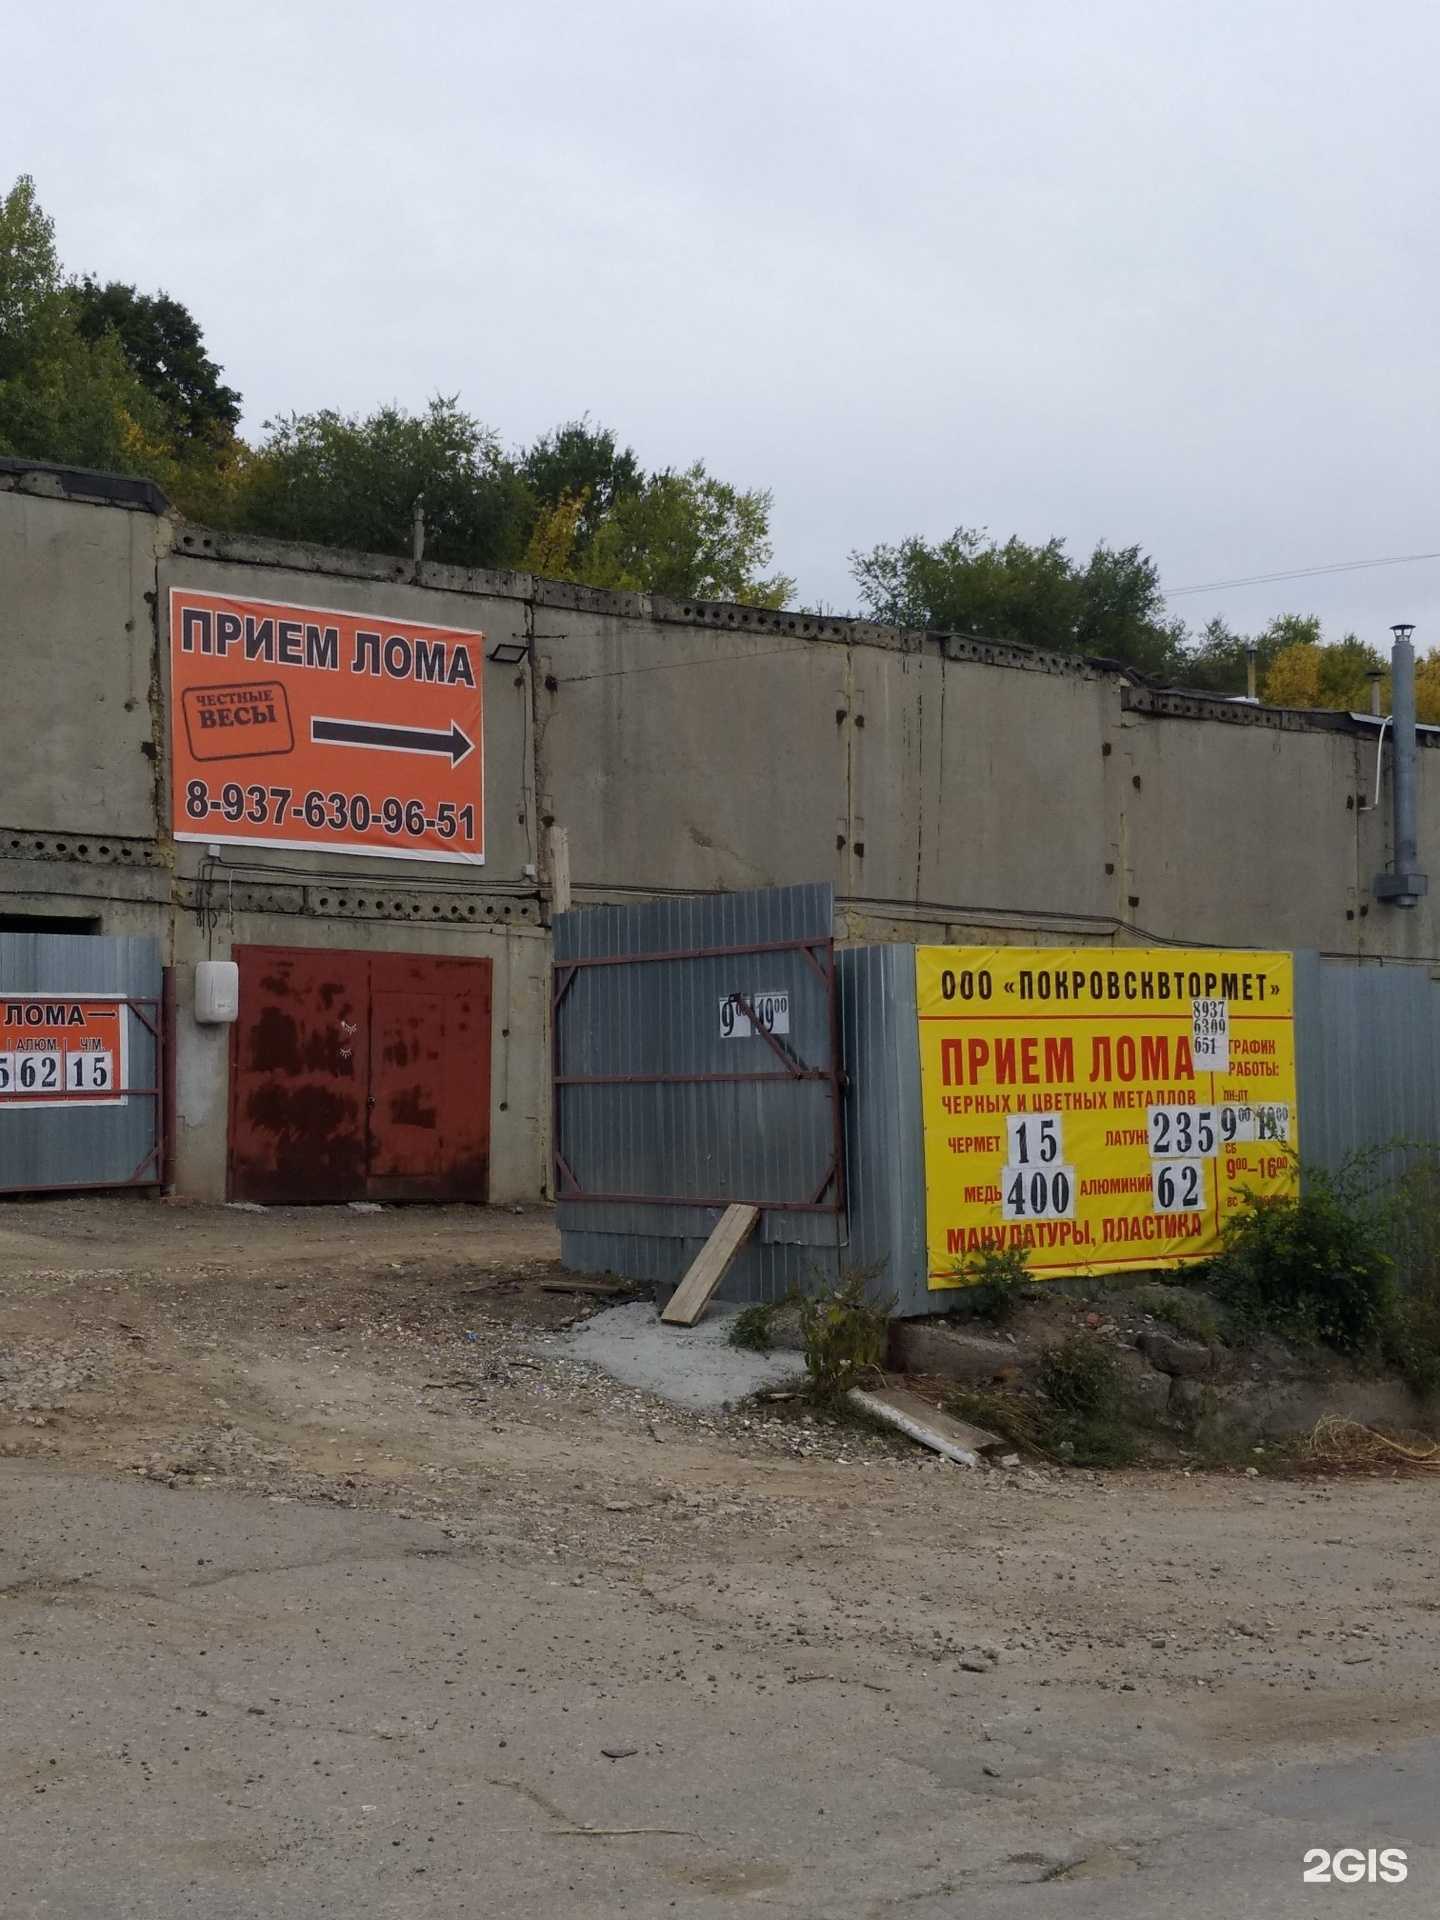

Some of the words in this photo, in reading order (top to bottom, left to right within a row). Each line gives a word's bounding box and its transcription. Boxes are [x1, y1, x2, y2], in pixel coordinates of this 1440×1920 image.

[181, 607, 339, 671] ПРИЕМ
[352, 631, 476, 688] ЛОМА
[196, 690, 273, 706] ЧЕСТНЫЕ
[198, 705, 277, 728] ВЕСЫ
[186, 779, 475, 840] 8-937-630-96-51
[941, 970, 992, 1000] ООО
[1004, 970, 1281, 1001] «ПОКРОВСКВТОРМЕТ»
[3, 1004, 87, 1027] ЛОМА
[1193, 1001, 1225, 1018] 8937
[940, 1036, 1075, 1086] ПРИЕМ
[1089, 1035, 1195, 1083] ЛОМА
[1228, 1040, 1275, 1055] ГРАФИК
[20, 1057, 57, 1087] 62
[74, 1057, 107, 1087] 15
[1228, 1061, 1279, 1077] РАБОТЫ:
[942, 1094, 1011, 1114] ЧЕРНЫХ
[1017, 1094, 1026, 1112] И
[1032, 1092, 1107, 1113] ЦВЕТНЫХ
[1113, 1090, 1195, 1108] МЕТАЛЛОВ
[948, 1136, 1000, 1153] ЧЕРМЕТ
[1016, 1120, 1057, 1163] 15
[1153, 1112, 1214, 1153] 235
[964, 1185, 1002, 1204] МЕДЬ
[1008, 1172, 1069, 1215] 400
[1080, 1174, 1153, 1196] АЛЮМИНИЙ
[1158, 1166, 1198, 1208] 62
[1103, 1213, 1202, 1243] ПЛАСТИКА
